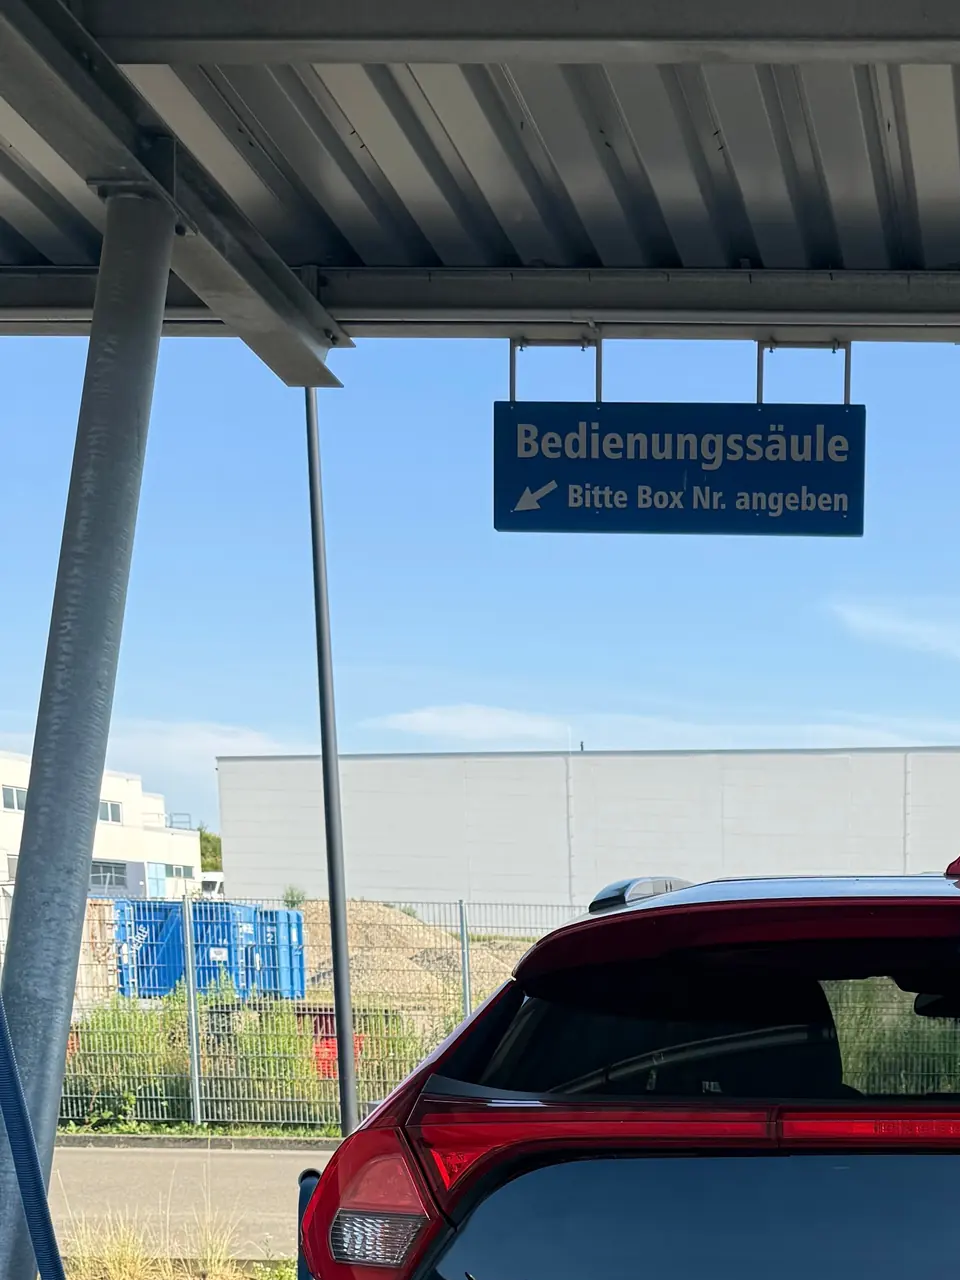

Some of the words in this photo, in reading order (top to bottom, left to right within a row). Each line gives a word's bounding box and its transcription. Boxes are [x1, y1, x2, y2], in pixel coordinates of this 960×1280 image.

[516, 421, 850, 471] Bedienungssäule
[567, 483, 628, 509] Bitte
[637, 484, 685, 510] Box
[692, 485, 727, 511] Nr.
[735, 485, 849, 517] angeben
